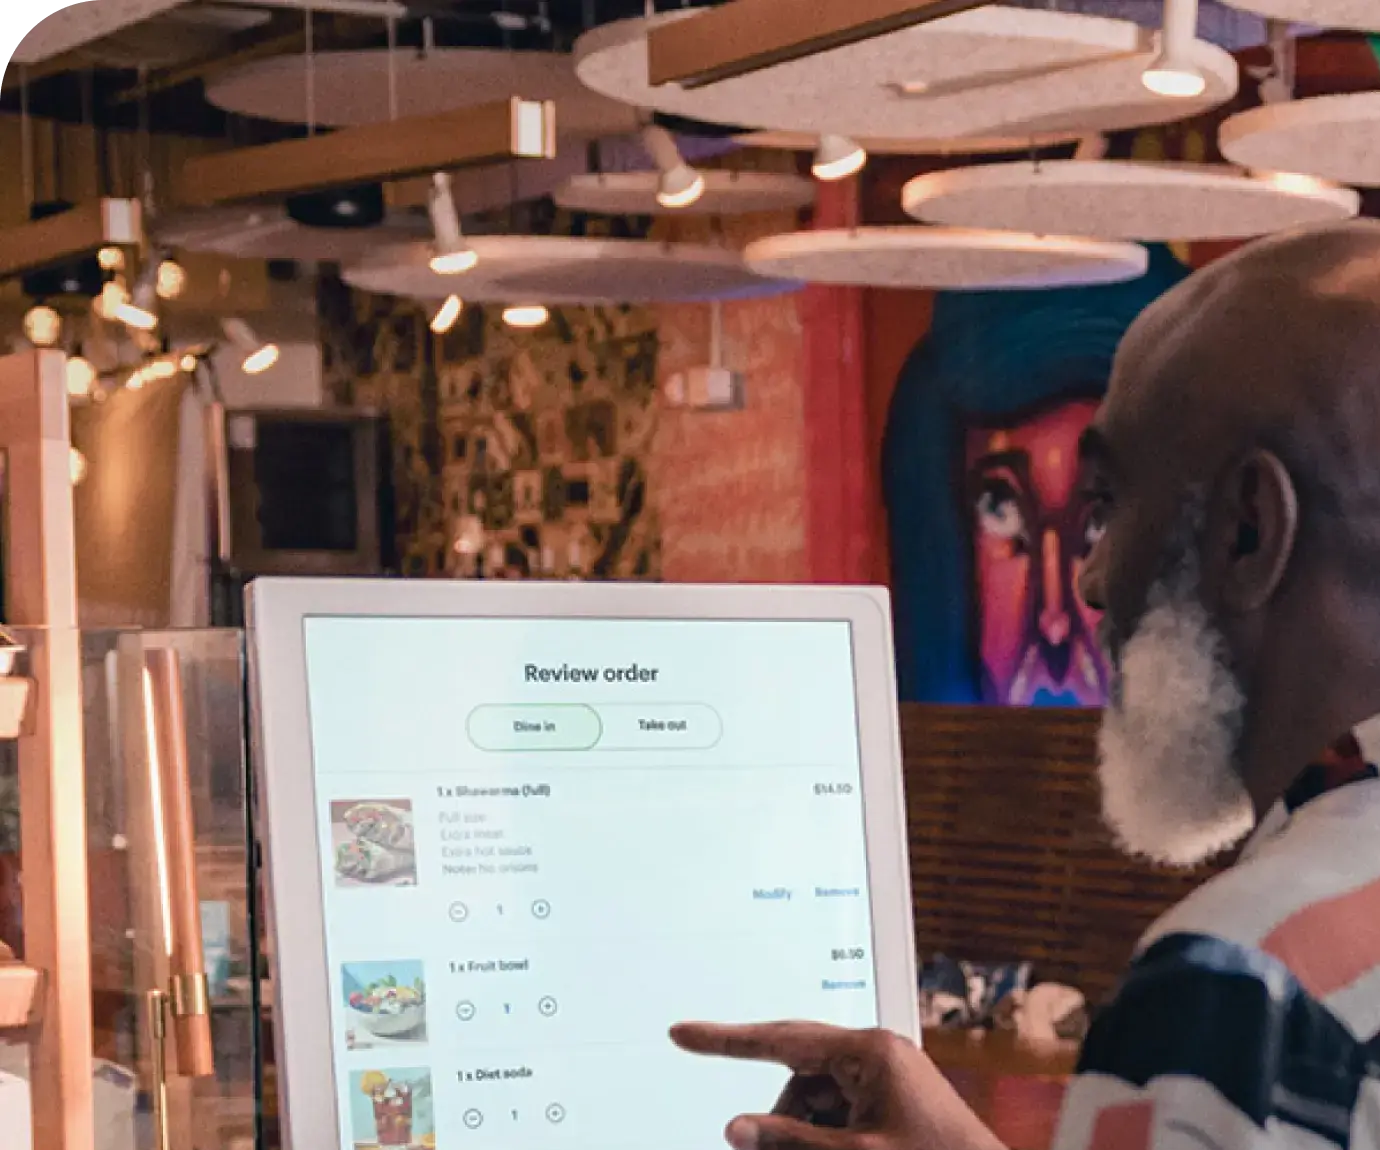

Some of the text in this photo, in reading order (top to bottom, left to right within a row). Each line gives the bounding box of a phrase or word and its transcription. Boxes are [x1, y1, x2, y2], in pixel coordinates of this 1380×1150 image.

[524, 663, 659, 682] Review order
[513, 720, 556, 732] Dine in
[638, 718, 687, 731] Take out
[455, 785, 519, 797] Shawarma
[522, 783, 551, 798] (full)
[752, 887, 792, 900] Modify
[467, 959, 496, 972] Fruit
[499, 957, 529, 971] bowl
[475, 1068, 501, 1081] Diet
[503, 1066, 533, 1079] soda
